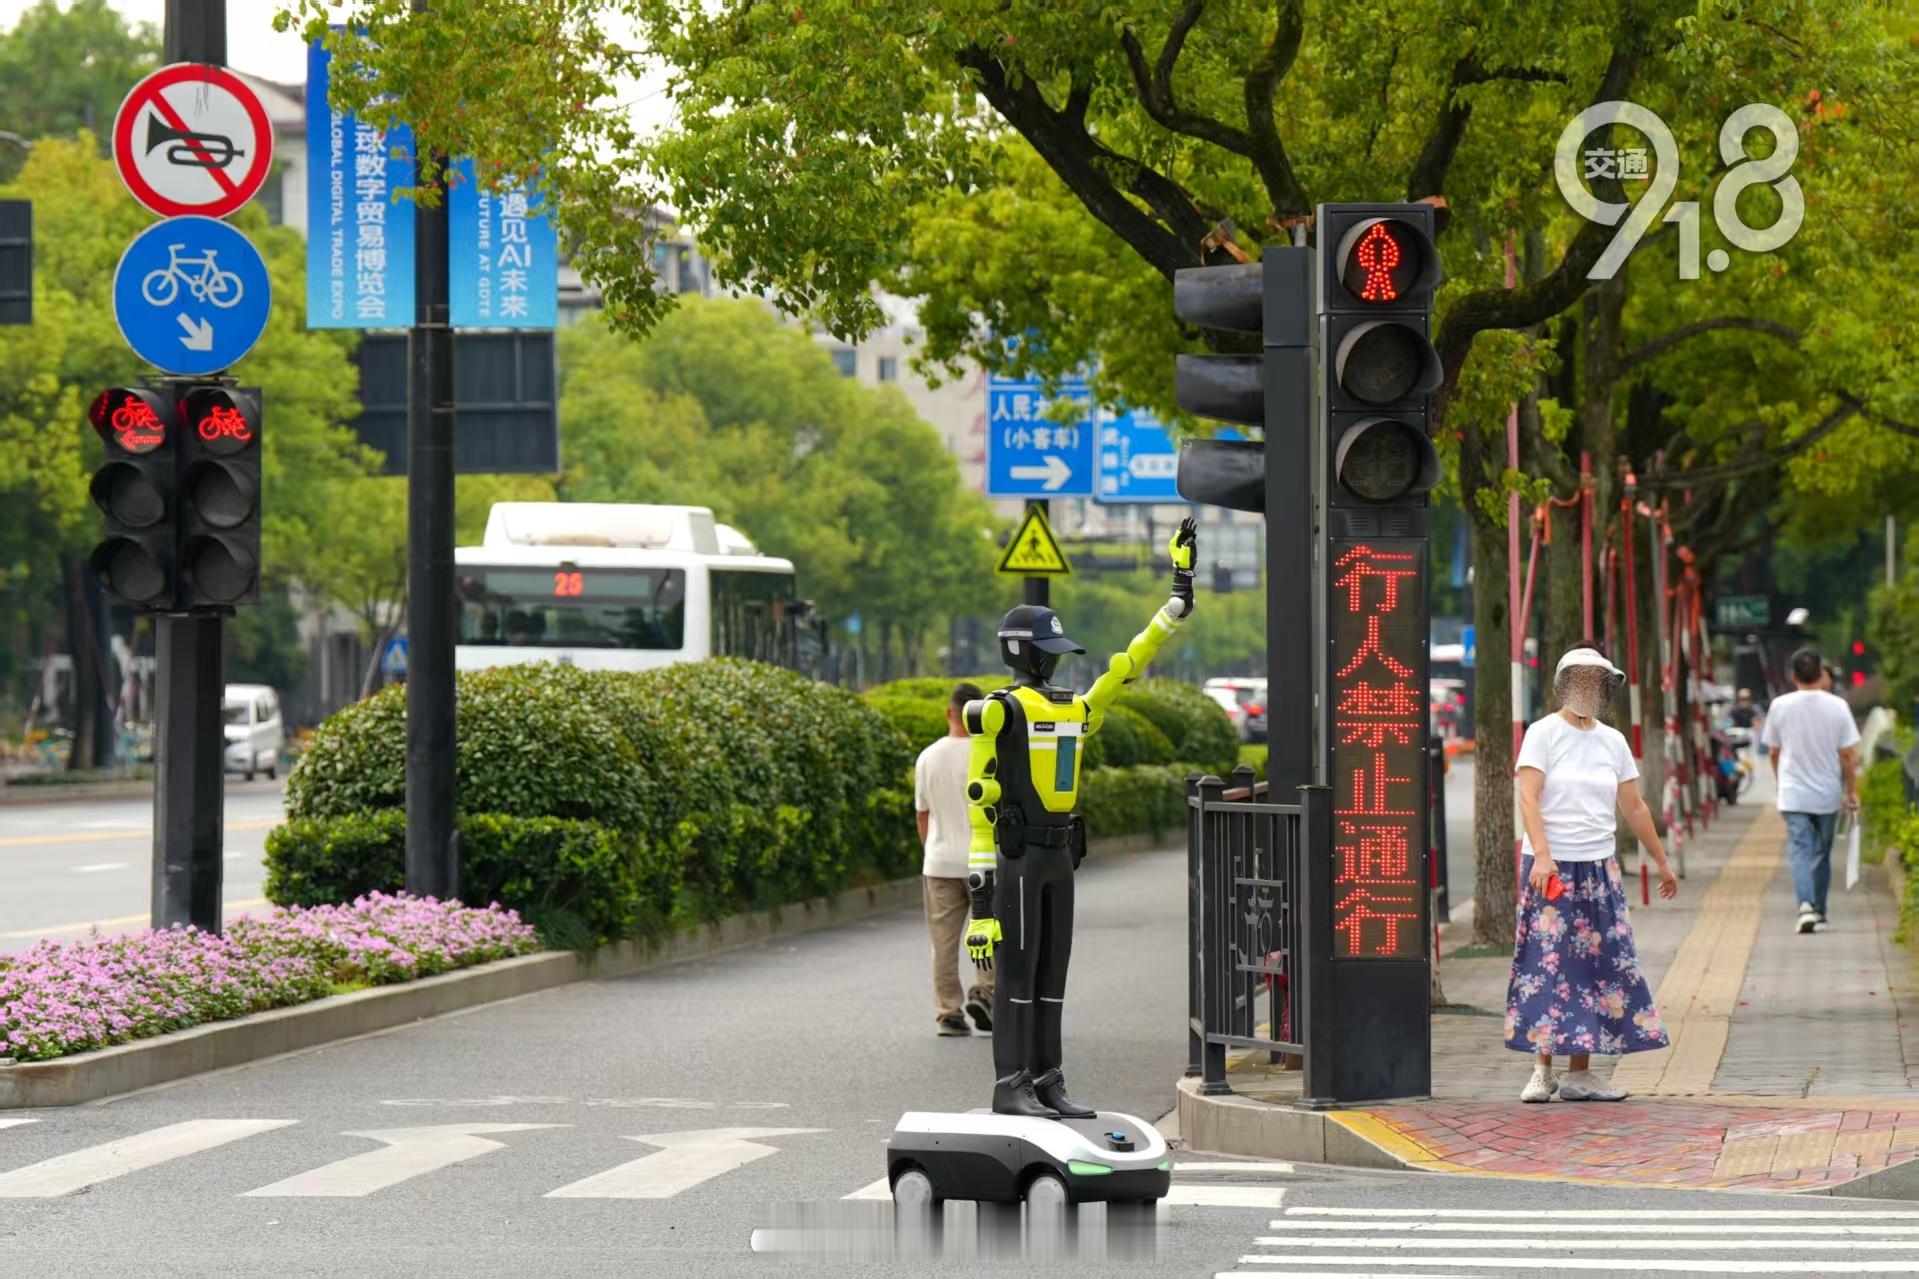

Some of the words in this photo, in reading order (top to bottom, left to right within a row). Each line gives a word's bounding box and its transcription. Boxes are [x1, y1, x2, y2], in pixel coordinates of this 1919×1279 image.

[330, 111, 344, 167] GLOBAL
[330, 170, 344, 226] DIGITAL
[478, 189, 490, 249] FUTURE
[330, 229, 344, 277] TRADE
[478, 253, 490, 272] AT
[330, 280, 344, 320] EXPO
[1333, 544, 1420, 957] 行人禁止通行
